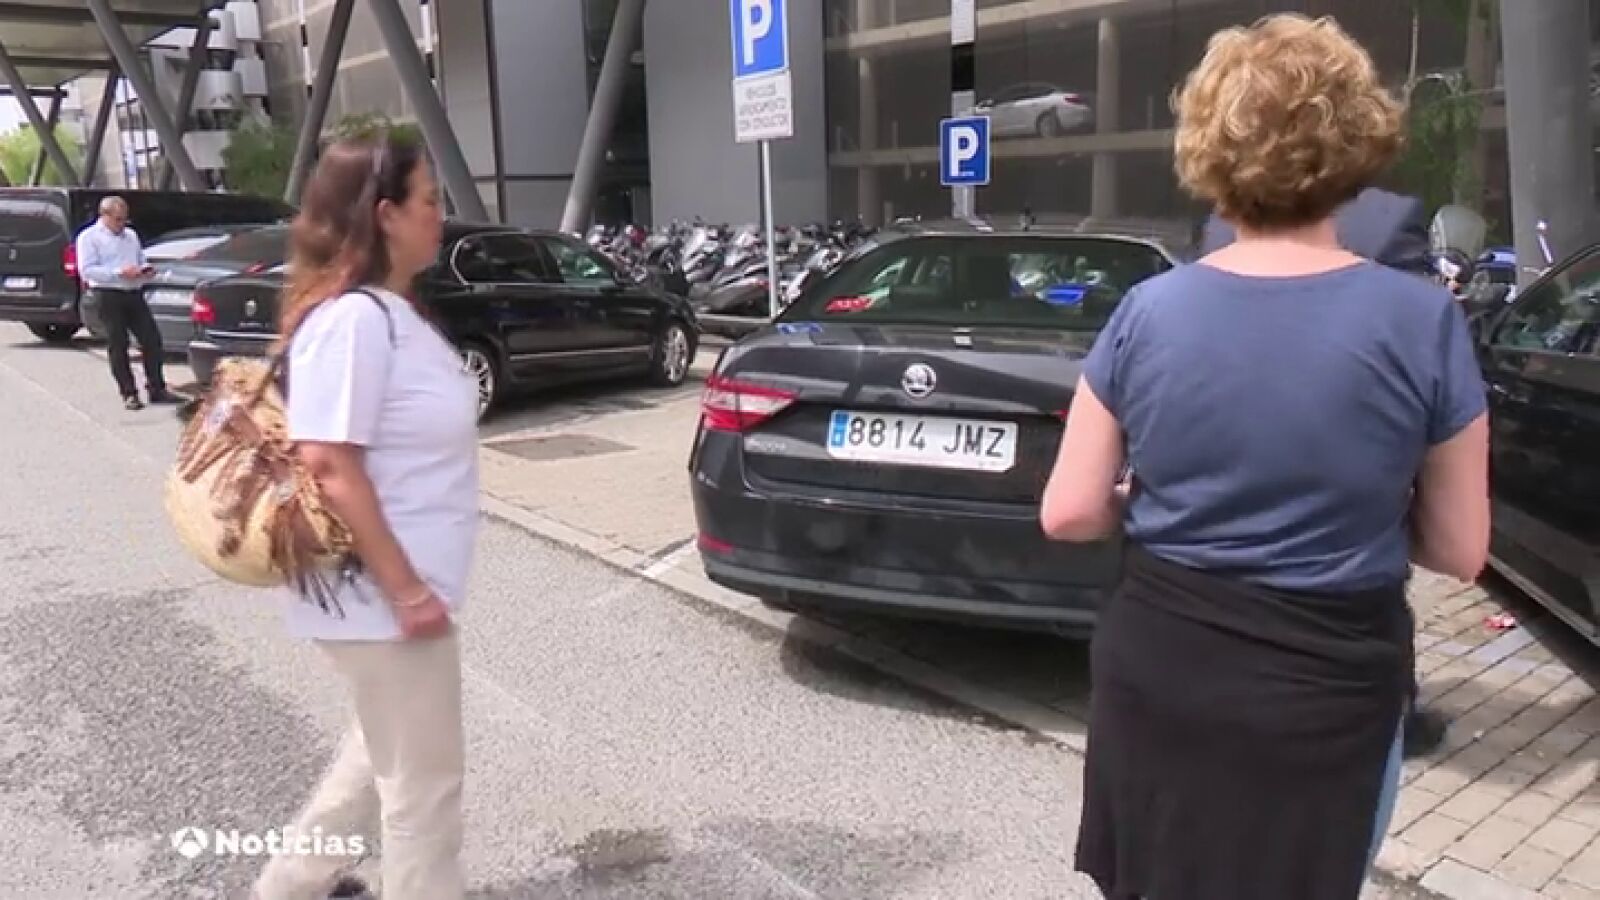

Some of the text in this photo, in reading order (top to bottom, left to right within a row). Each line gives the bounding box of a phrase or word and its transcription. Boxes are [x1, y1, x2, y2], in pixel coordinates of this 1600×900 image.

[740, 0, 773, 65] P
[949, 126, 979, 177] P
[848, 416, 1006, 457] 8814 JMZ
